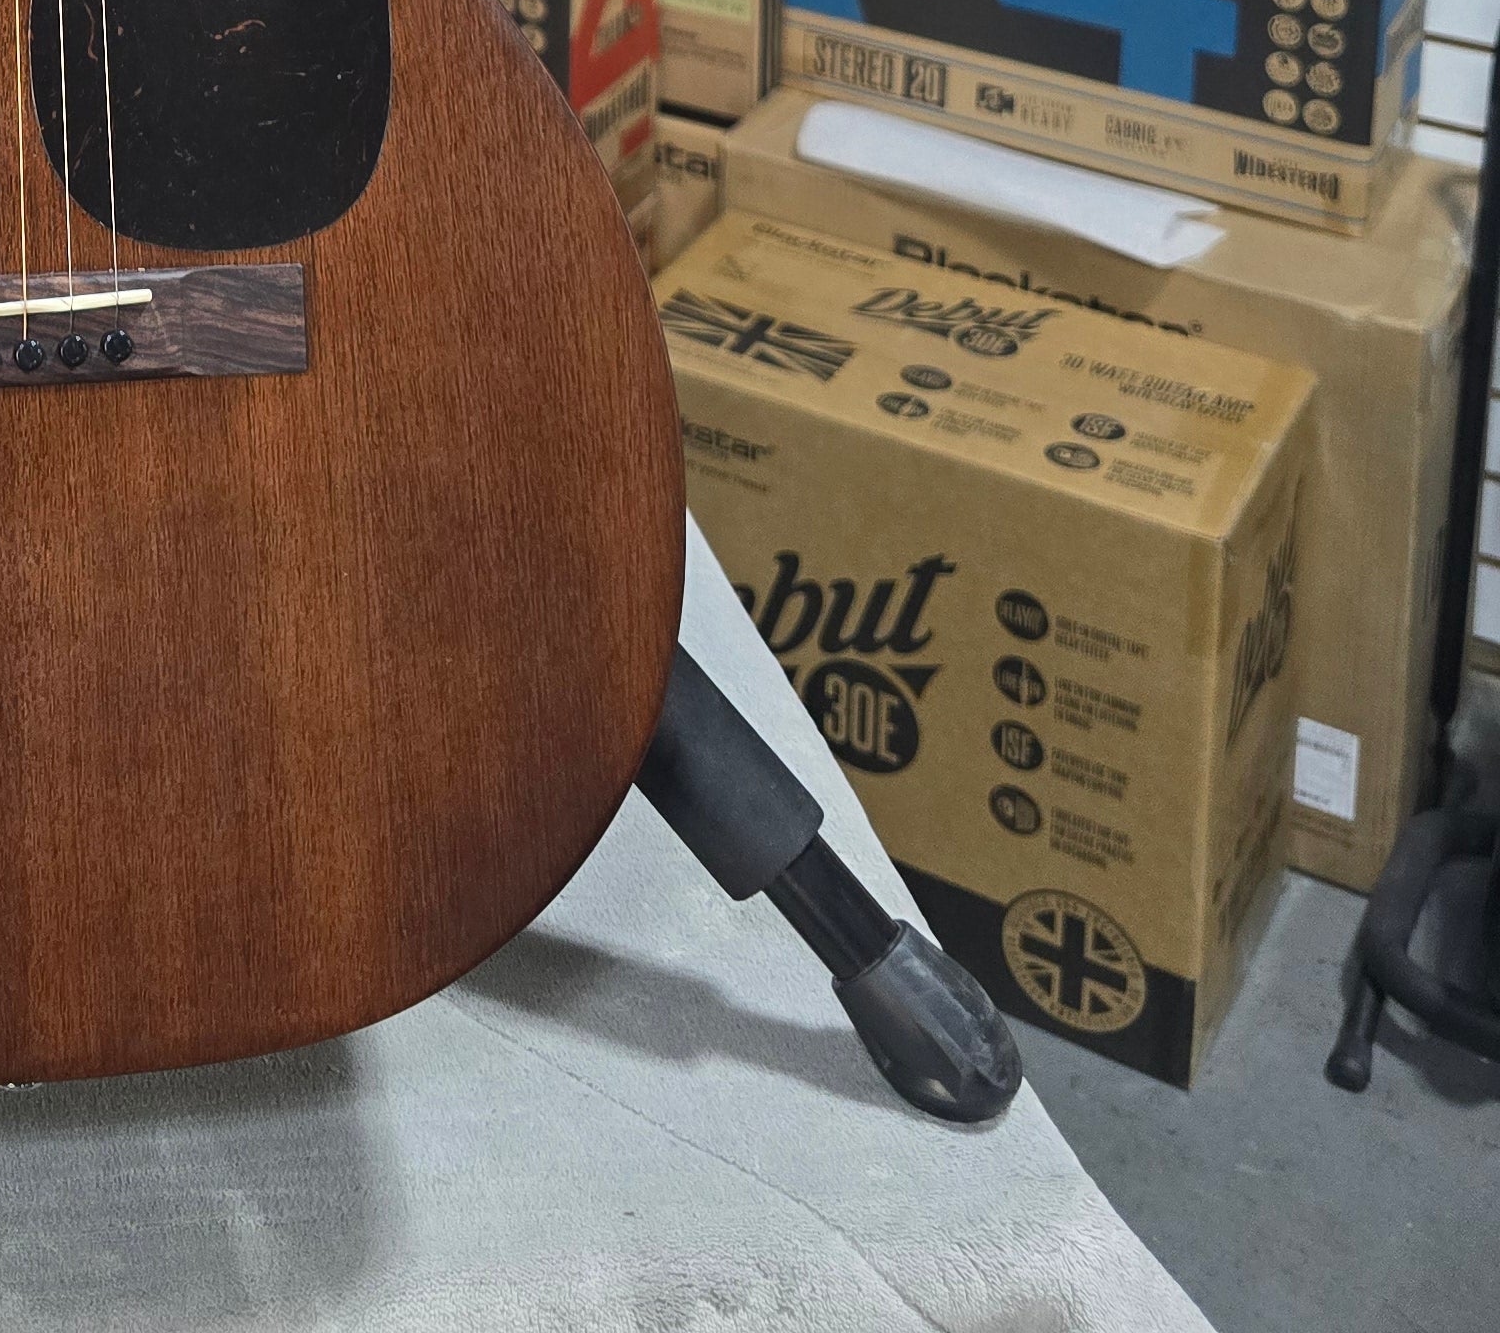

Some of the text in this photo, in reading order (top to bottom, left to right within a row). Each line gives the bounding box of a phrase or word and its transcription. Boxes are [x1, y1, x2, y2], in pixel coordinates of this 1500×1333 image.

[813, 34, 944, 107] STEREO 20
[852, 286, 1063, 333] Debut
[822, 672, 901, 765] 30E
